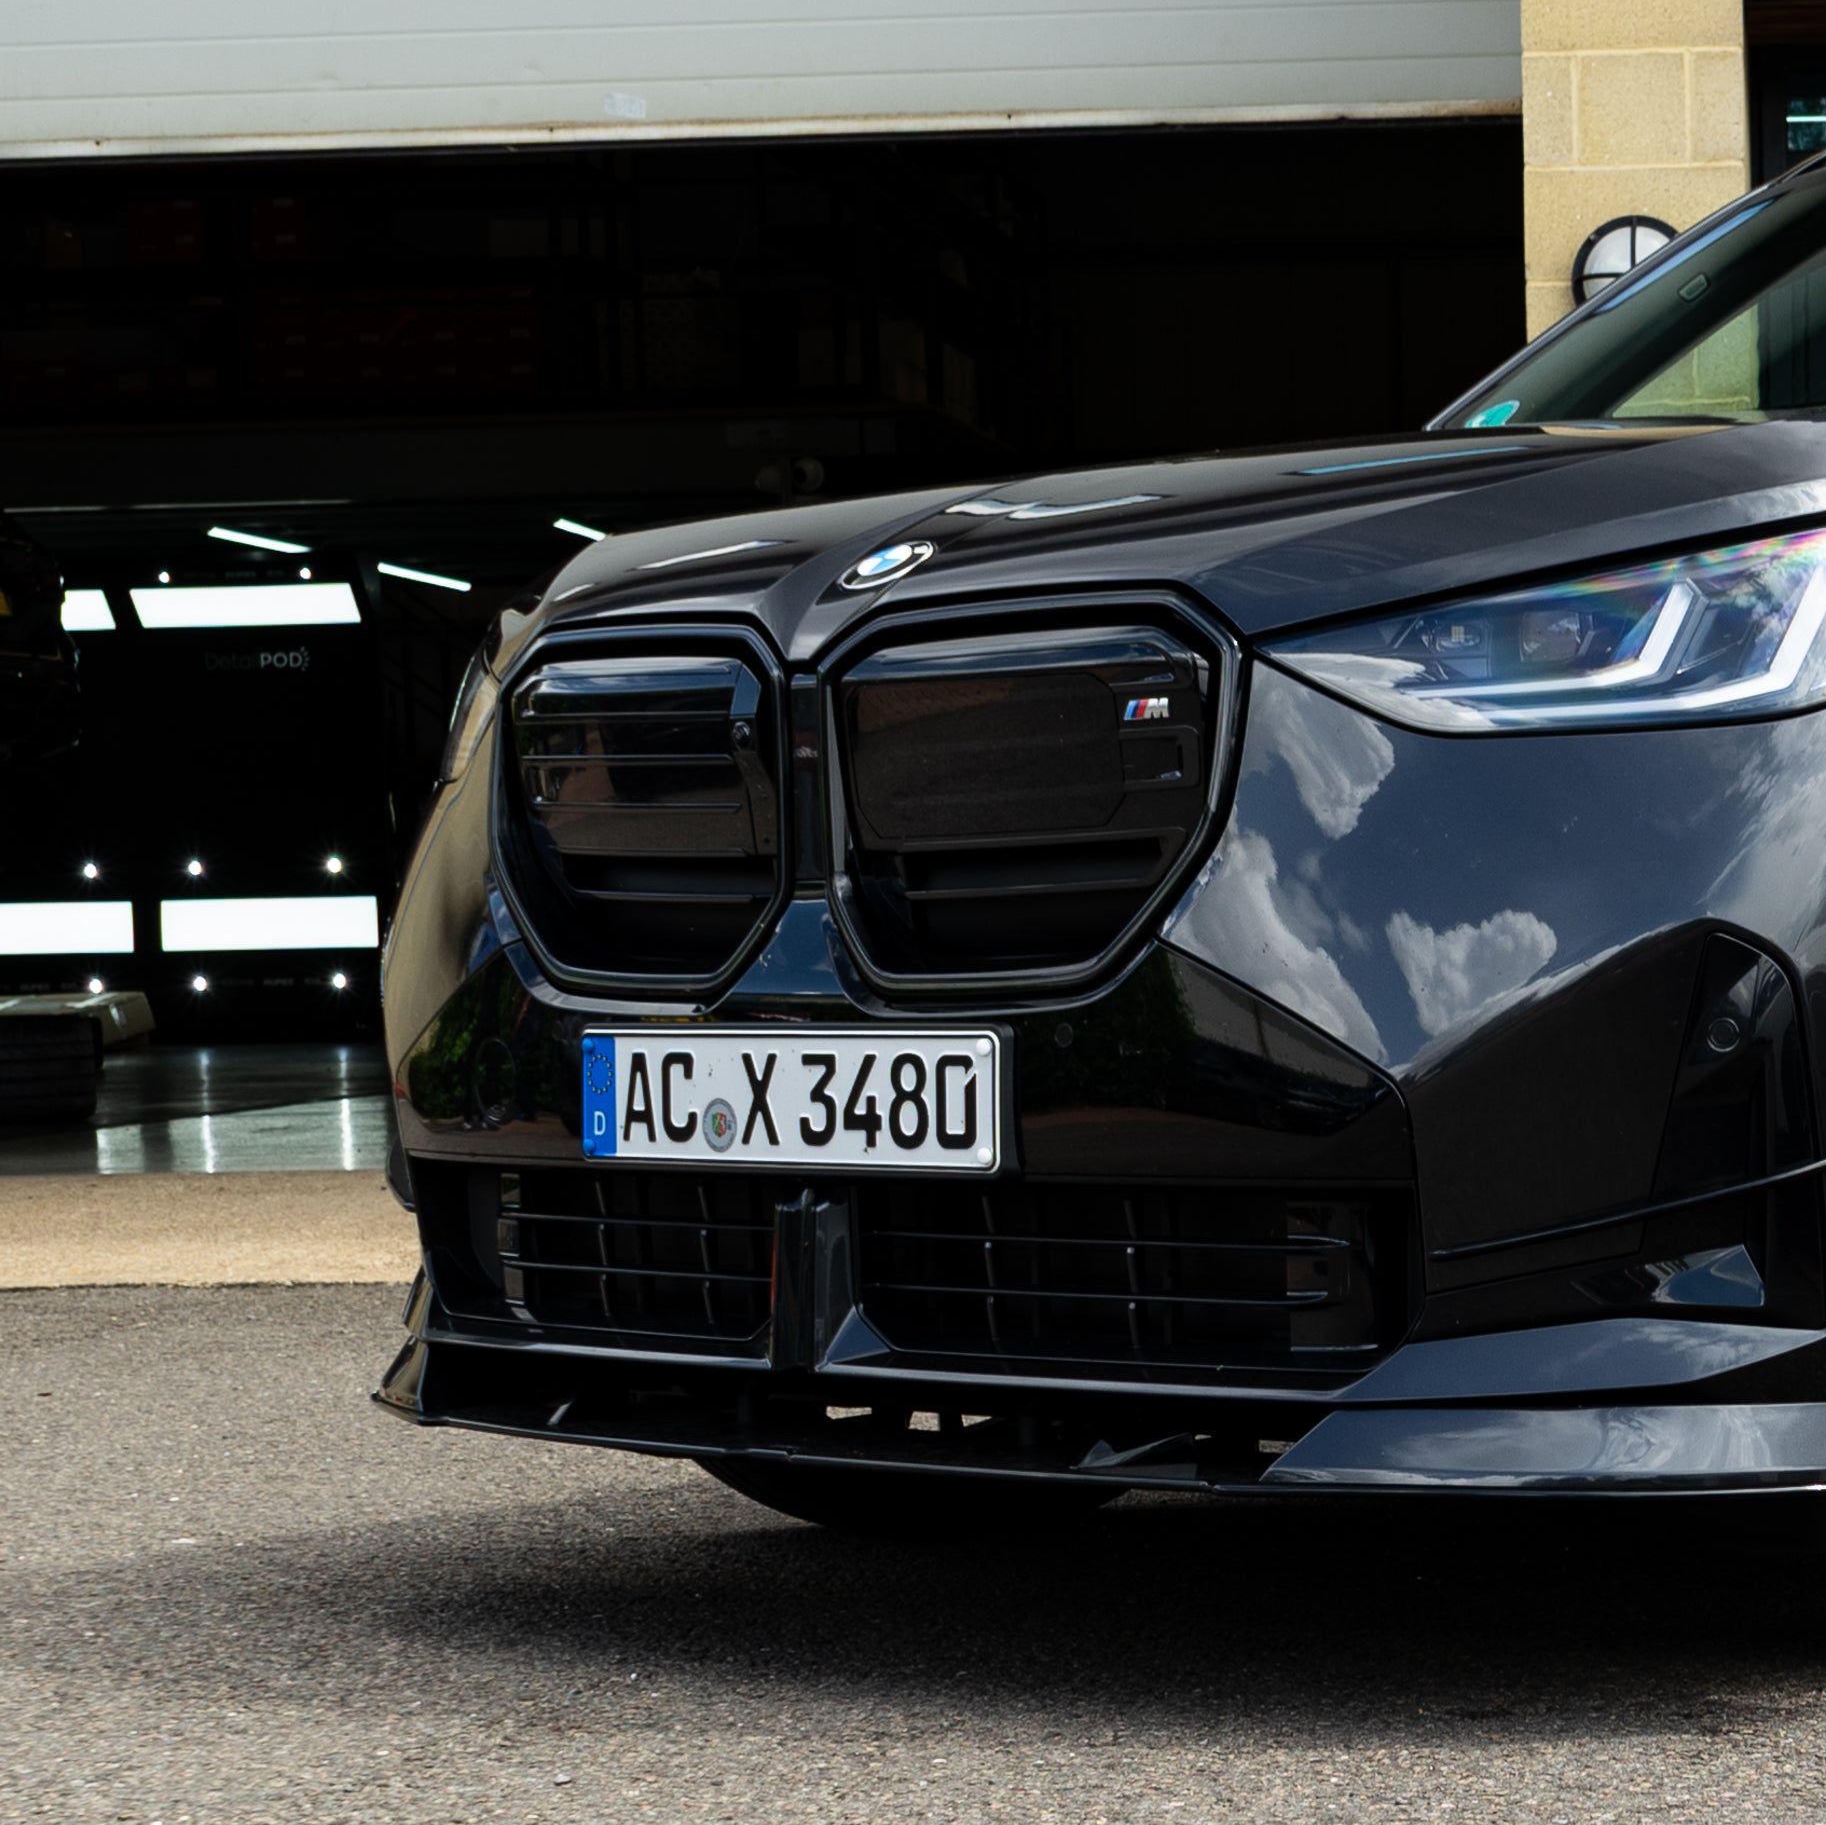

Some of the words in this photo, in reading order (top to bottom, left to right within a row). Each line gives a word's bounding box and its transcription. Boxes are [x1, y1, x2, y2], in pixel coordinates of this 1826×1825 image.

[593, 1111, 607, 1136] D
[623, 1052, 698, 1143] AC
[741, 1053, 780, 1145] X
[800, 1053, 977, 1150] 3480
